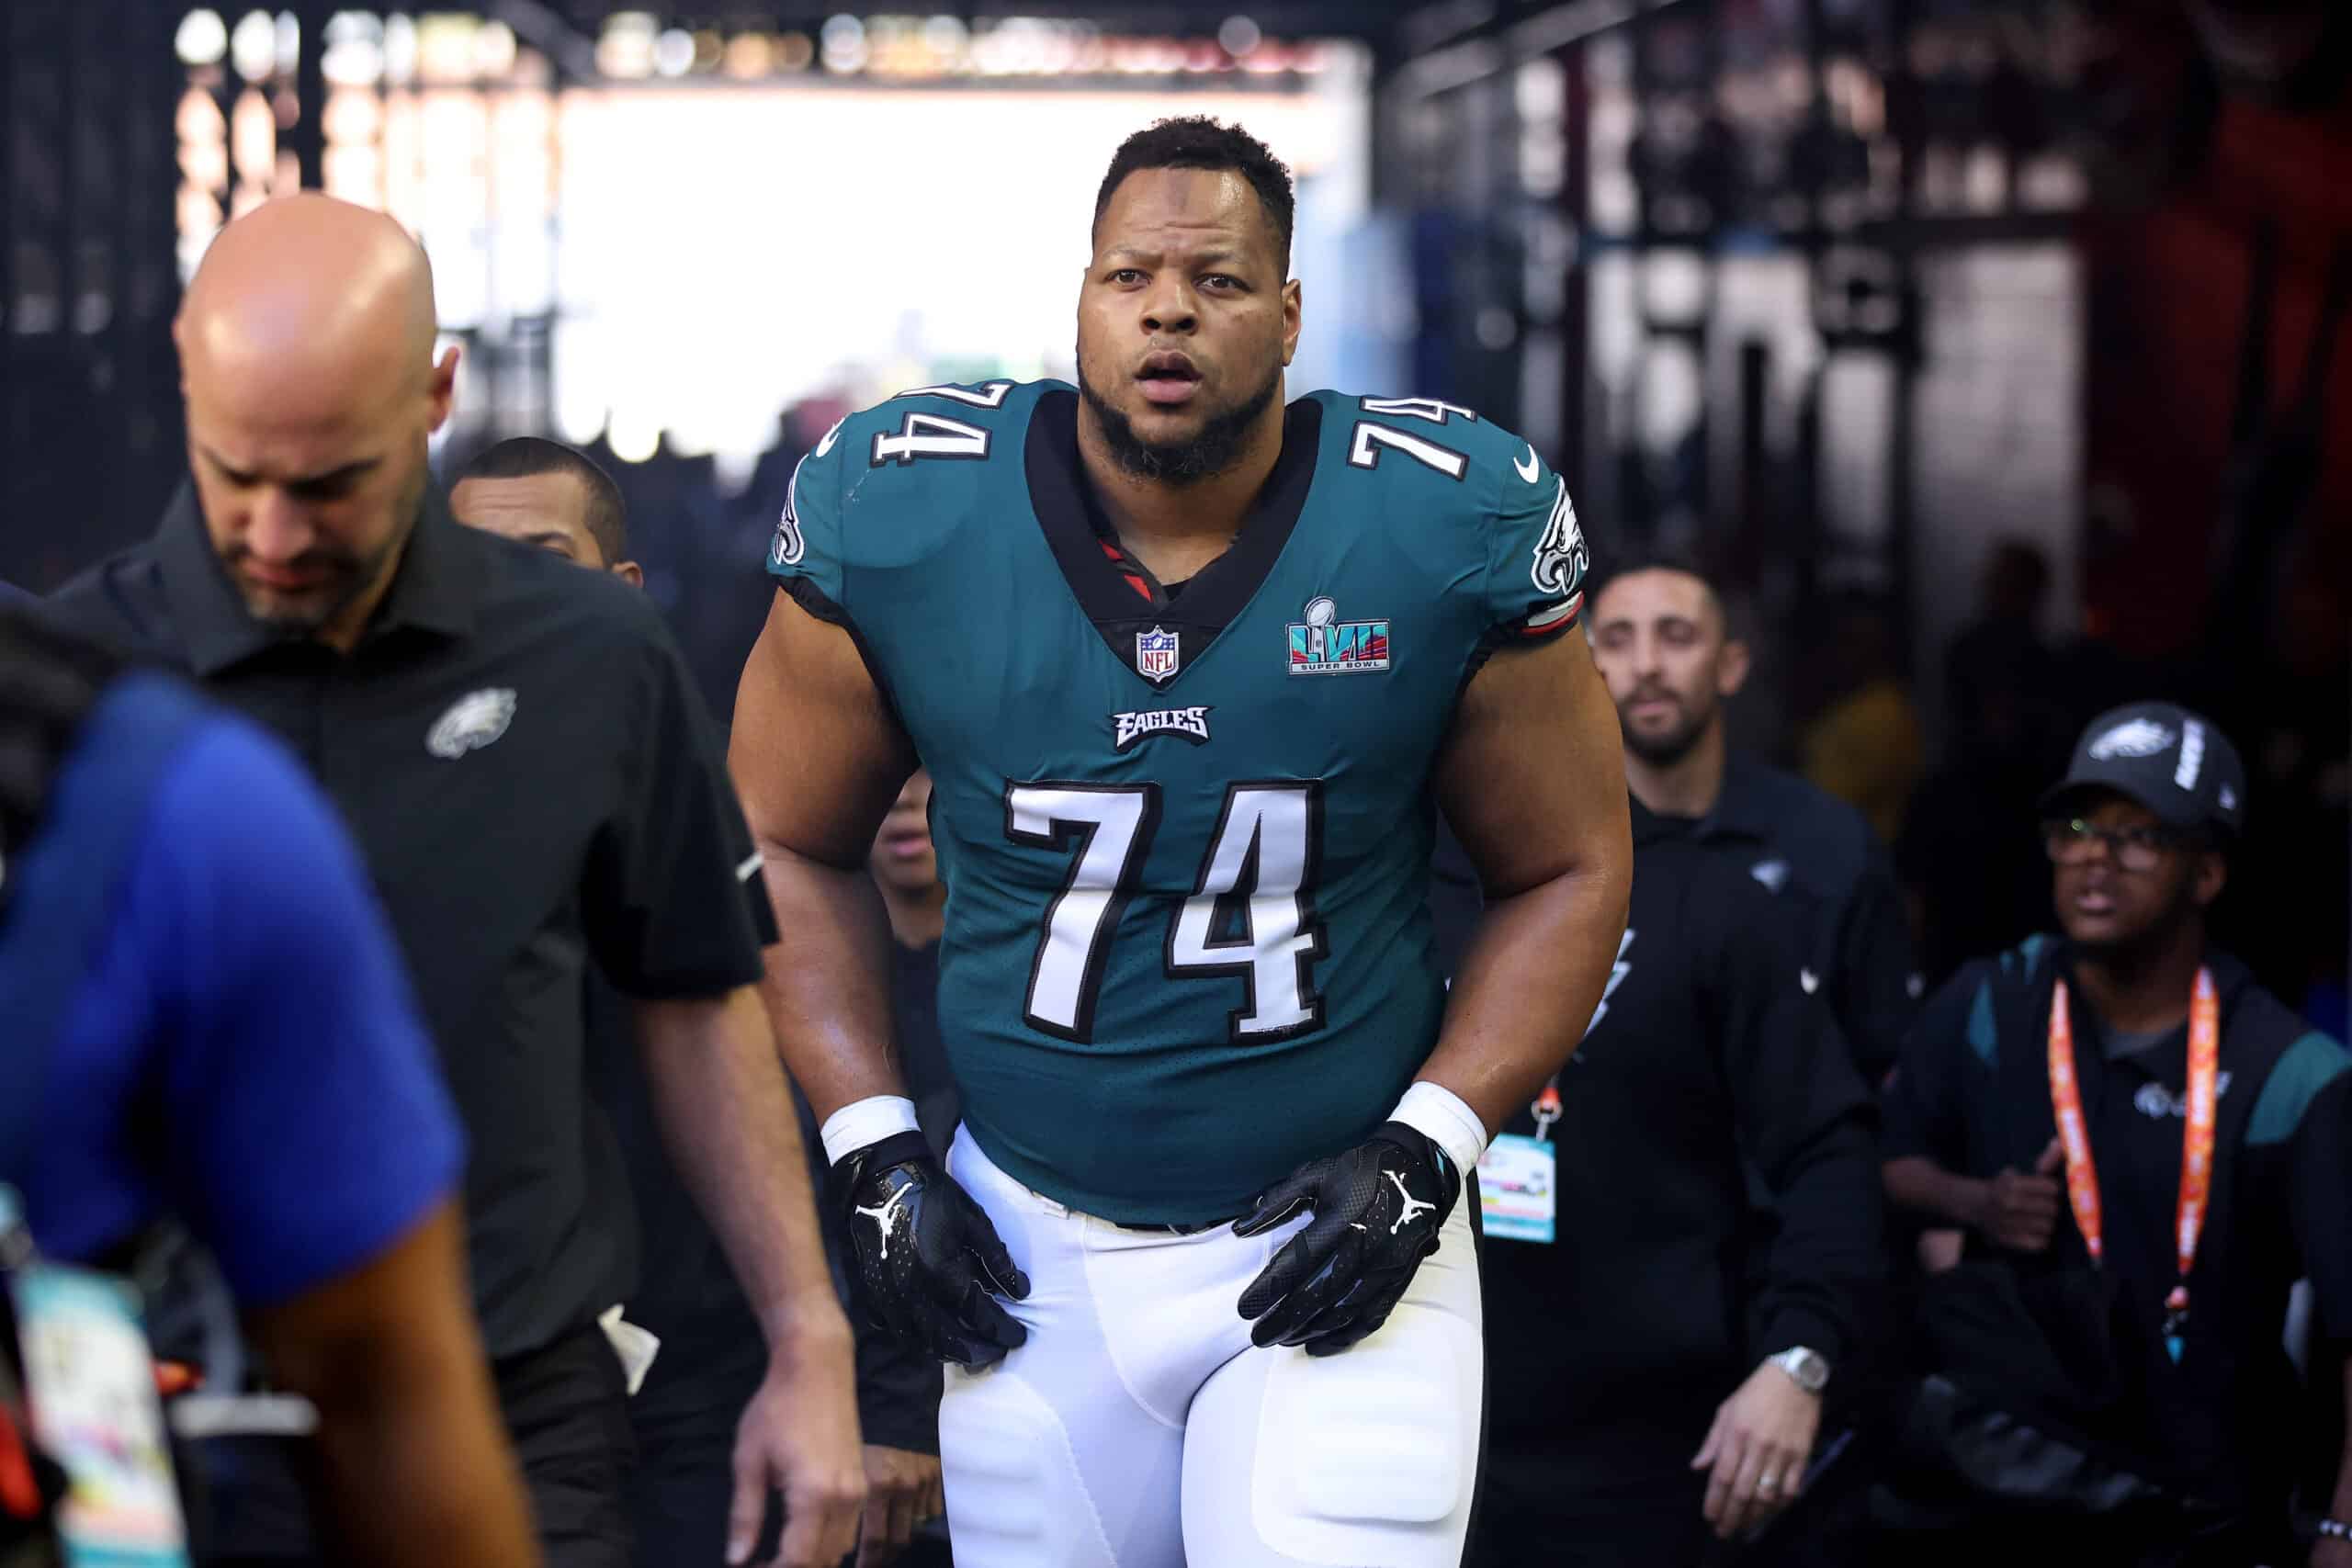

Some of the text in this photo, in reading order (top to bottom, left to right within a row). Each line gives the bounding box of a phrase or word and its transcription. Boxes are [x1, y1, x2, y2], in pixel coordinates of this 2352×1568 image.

[1144, 651, 1173, 672] NFL
[1301, 660, 1379, 671] SUPER BOWL
[1113, 706, 1209, 748] EAGLES
[1004, 777, 1329, 1044] 74
